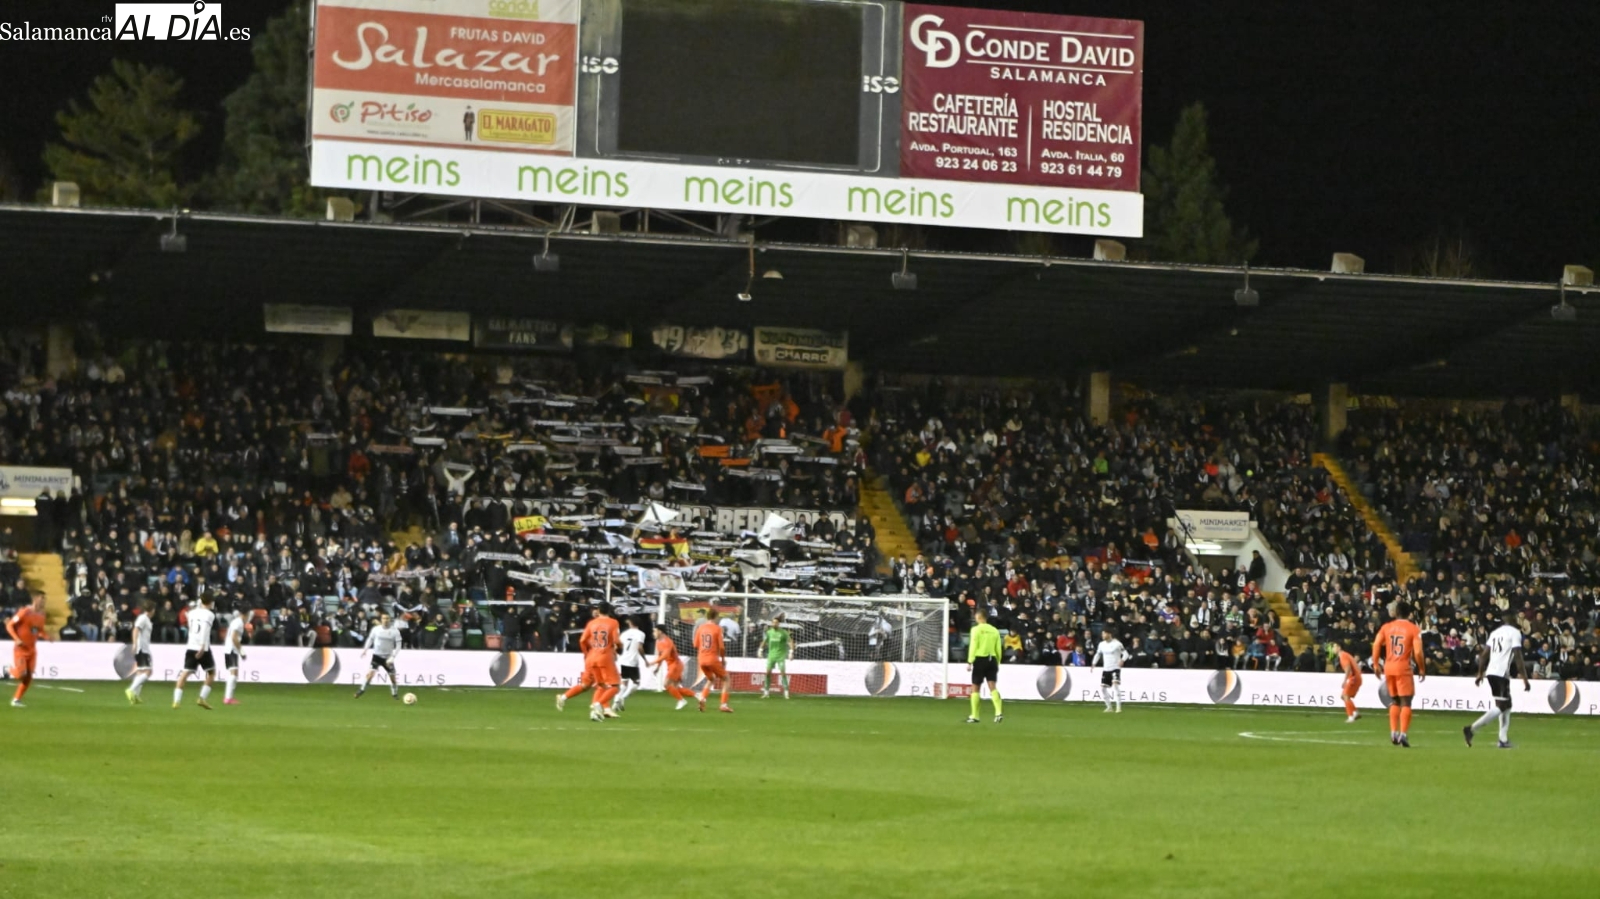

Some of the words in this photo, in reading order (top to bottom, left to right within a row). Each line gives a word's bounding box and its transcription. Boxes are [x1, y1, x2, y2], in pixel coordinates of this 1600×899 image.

[450, 27, 499, 42] FRUTAS
[503, 30, 546, 45] DAVID
[332, 21, 560, 77] Salazar
[965, 30, 1050, 62] CONDE
[1061, 36, 1135, 68] DAVID
[415, 72, 546, 94] Mercasalamanca
[990, 67, 1107, 87] SALAMANCA
[361, 100, 432, 124] Pitiso
[933, 93, 1019, 118] CAFETERÍA
[1043, 100, 1102, 123] HOSTAL
[496, 115, 551, 134] MARAGATO
[908, 112, 1019, 139] RESTAURANTE
[1042, 121, 1133, 145] RESIDENCIA
[998, 147, 1018, 158] 163
[1110, 153, 1125, 163] 60
[347, 154, 461, 187] meins
[936, 157, 960, 170] 923
[963, 158, 979, 171] 24
[982, 159, 999, 171] 06
[1002, 160, 1018, 173] 23
[1041, 163, 1065, 175] 923
[1068, 164, 1083, 176] 61
[1087, 165, 1103, 177] 44
[1107, 166, 1122, 178] 79
[518, 164, 629, 198] meins
[684, 175, 794, 209] meins
[848, 185, 955, 219] meins
[1007, 196, 1112, 229] meins
[509, 332, 537, 345] FANS
[775, 348, 830, 363] CHARRO
[14, 474, 70, 485] MINIMARKET
[1199, 518, 1248, 527] MINIMARKET
[701, 633, 712, 650] 19
[1389, 634, 1404, 656] 15
[1251, 694, 1335, 705] PANELAIS
